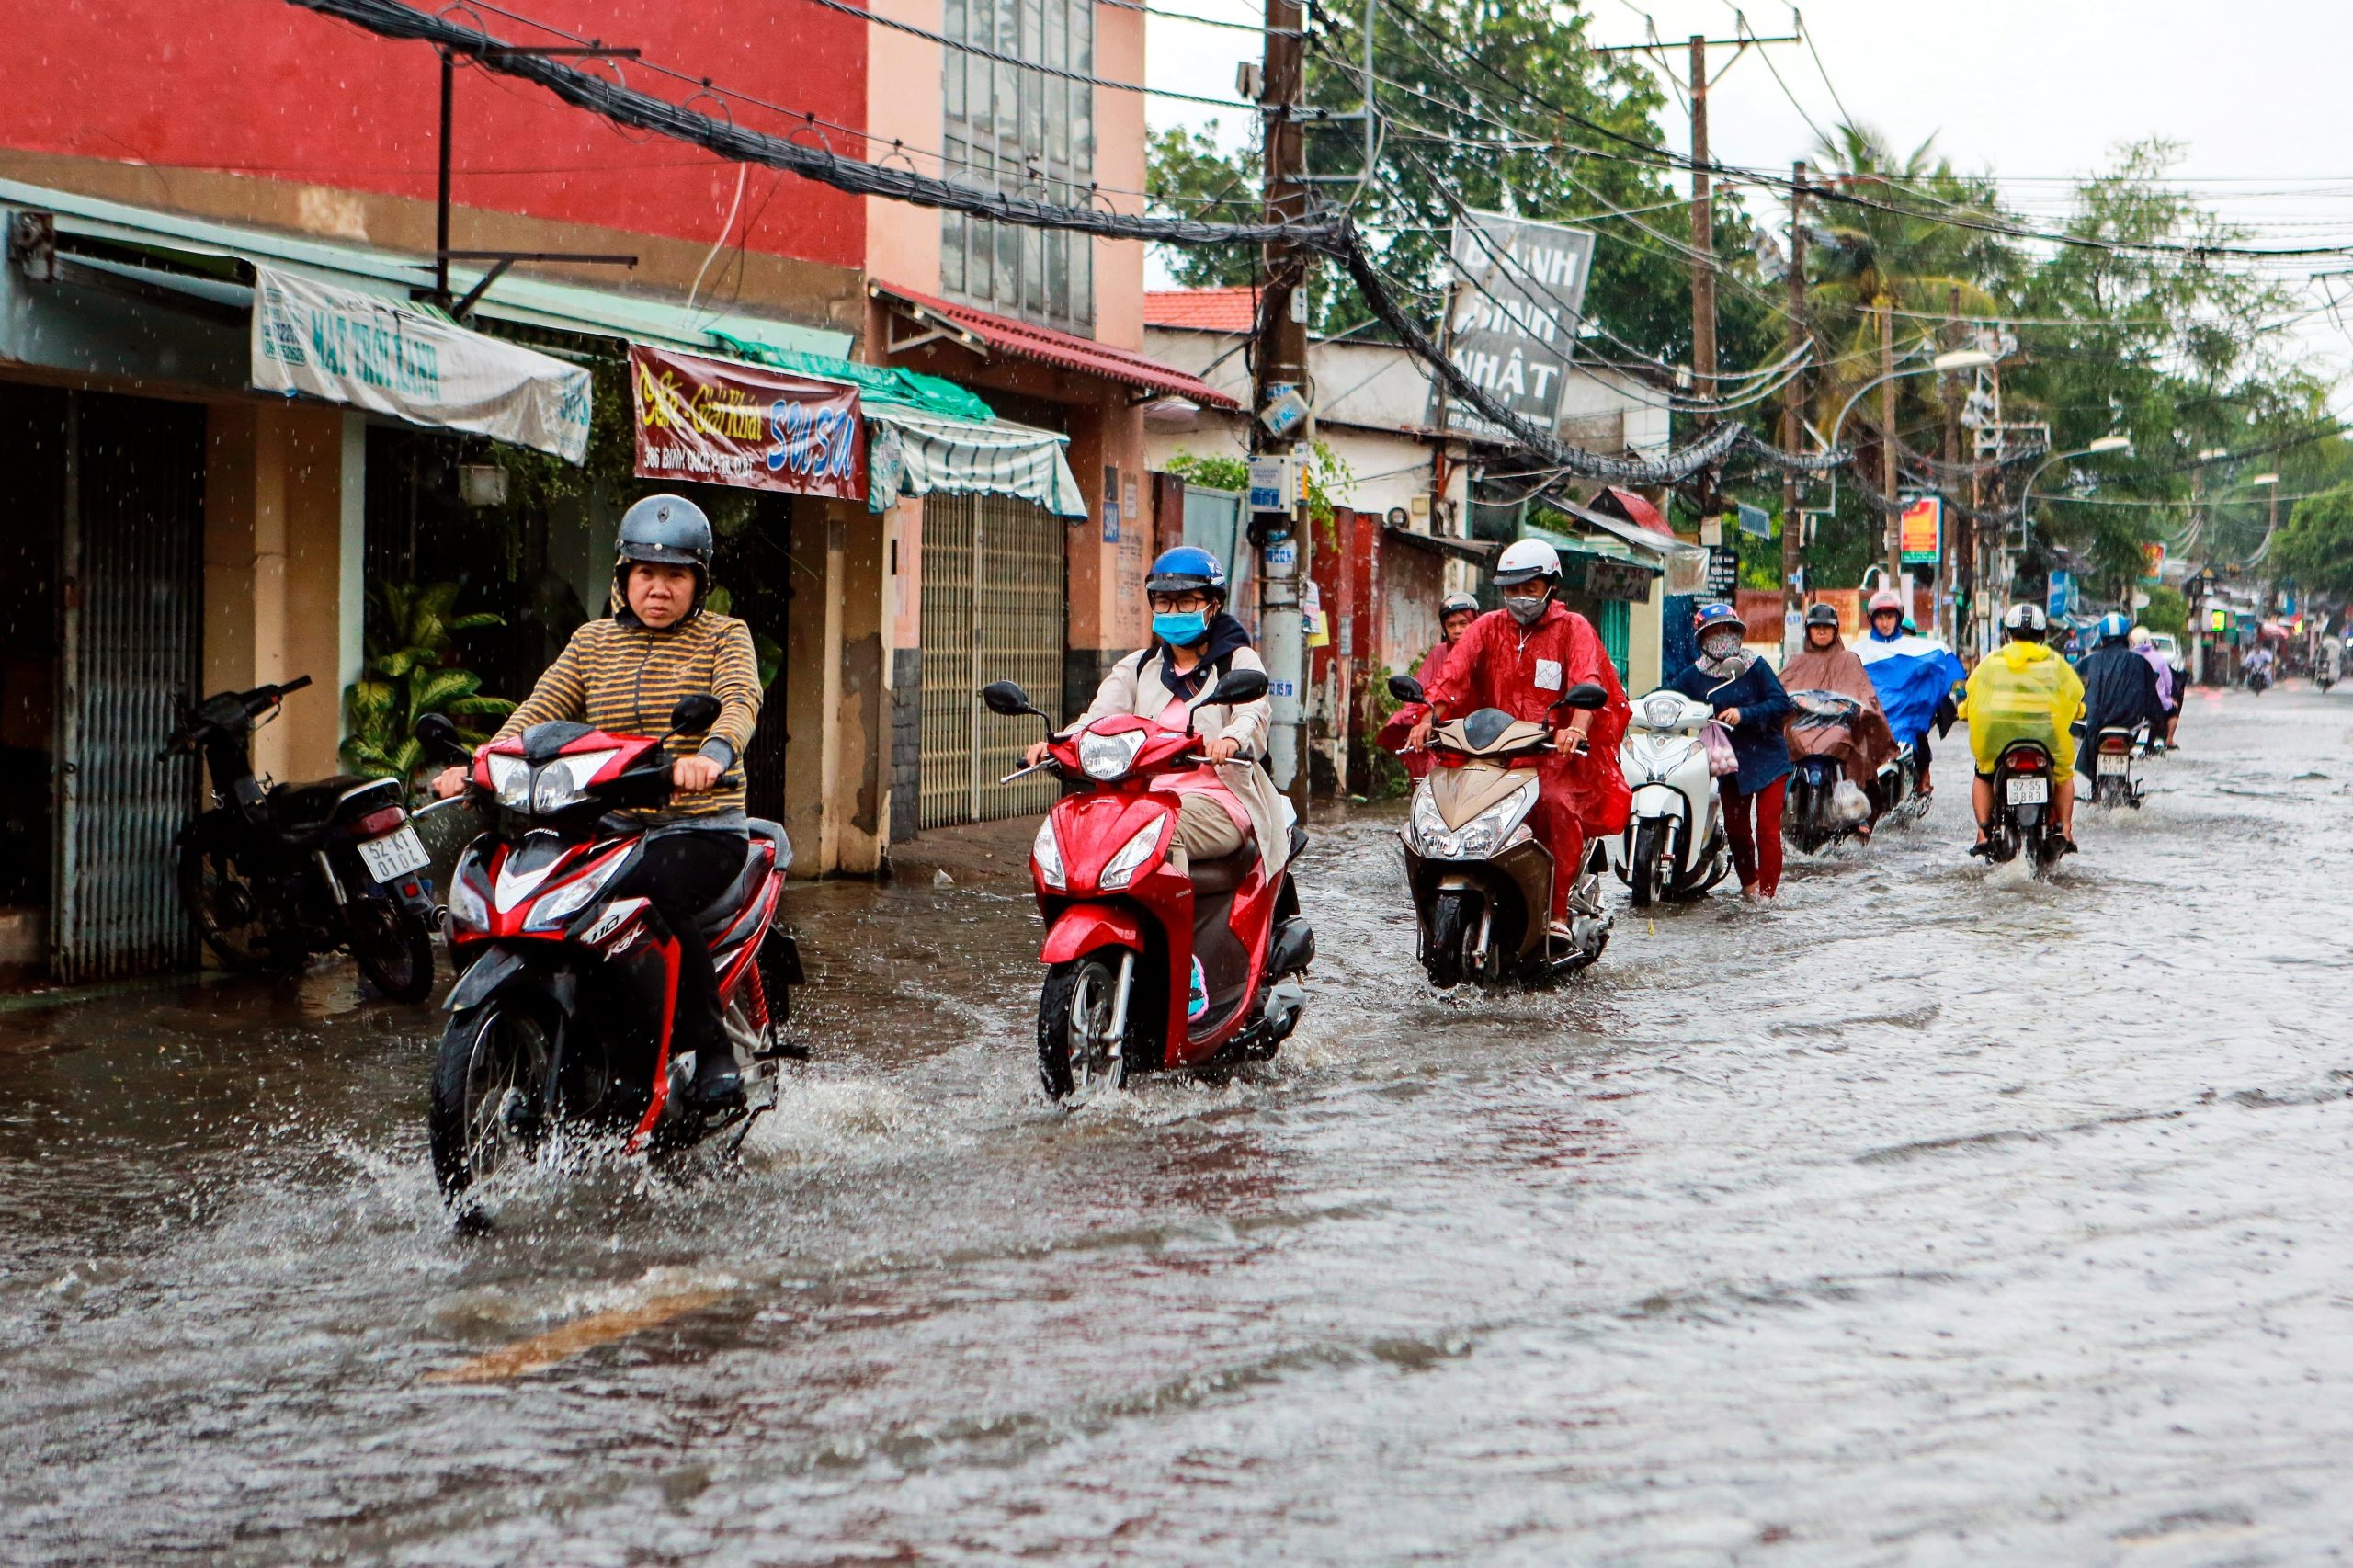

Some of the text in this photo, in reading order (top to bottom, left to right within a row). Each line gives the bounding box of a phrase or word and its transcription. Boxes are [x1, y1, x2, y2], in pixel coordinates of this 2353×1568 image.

[368, 833, 410, 859] 52-K1
[378, 849, 420, 877] 0104
[1176, 888, 1192, 899] HONDA
